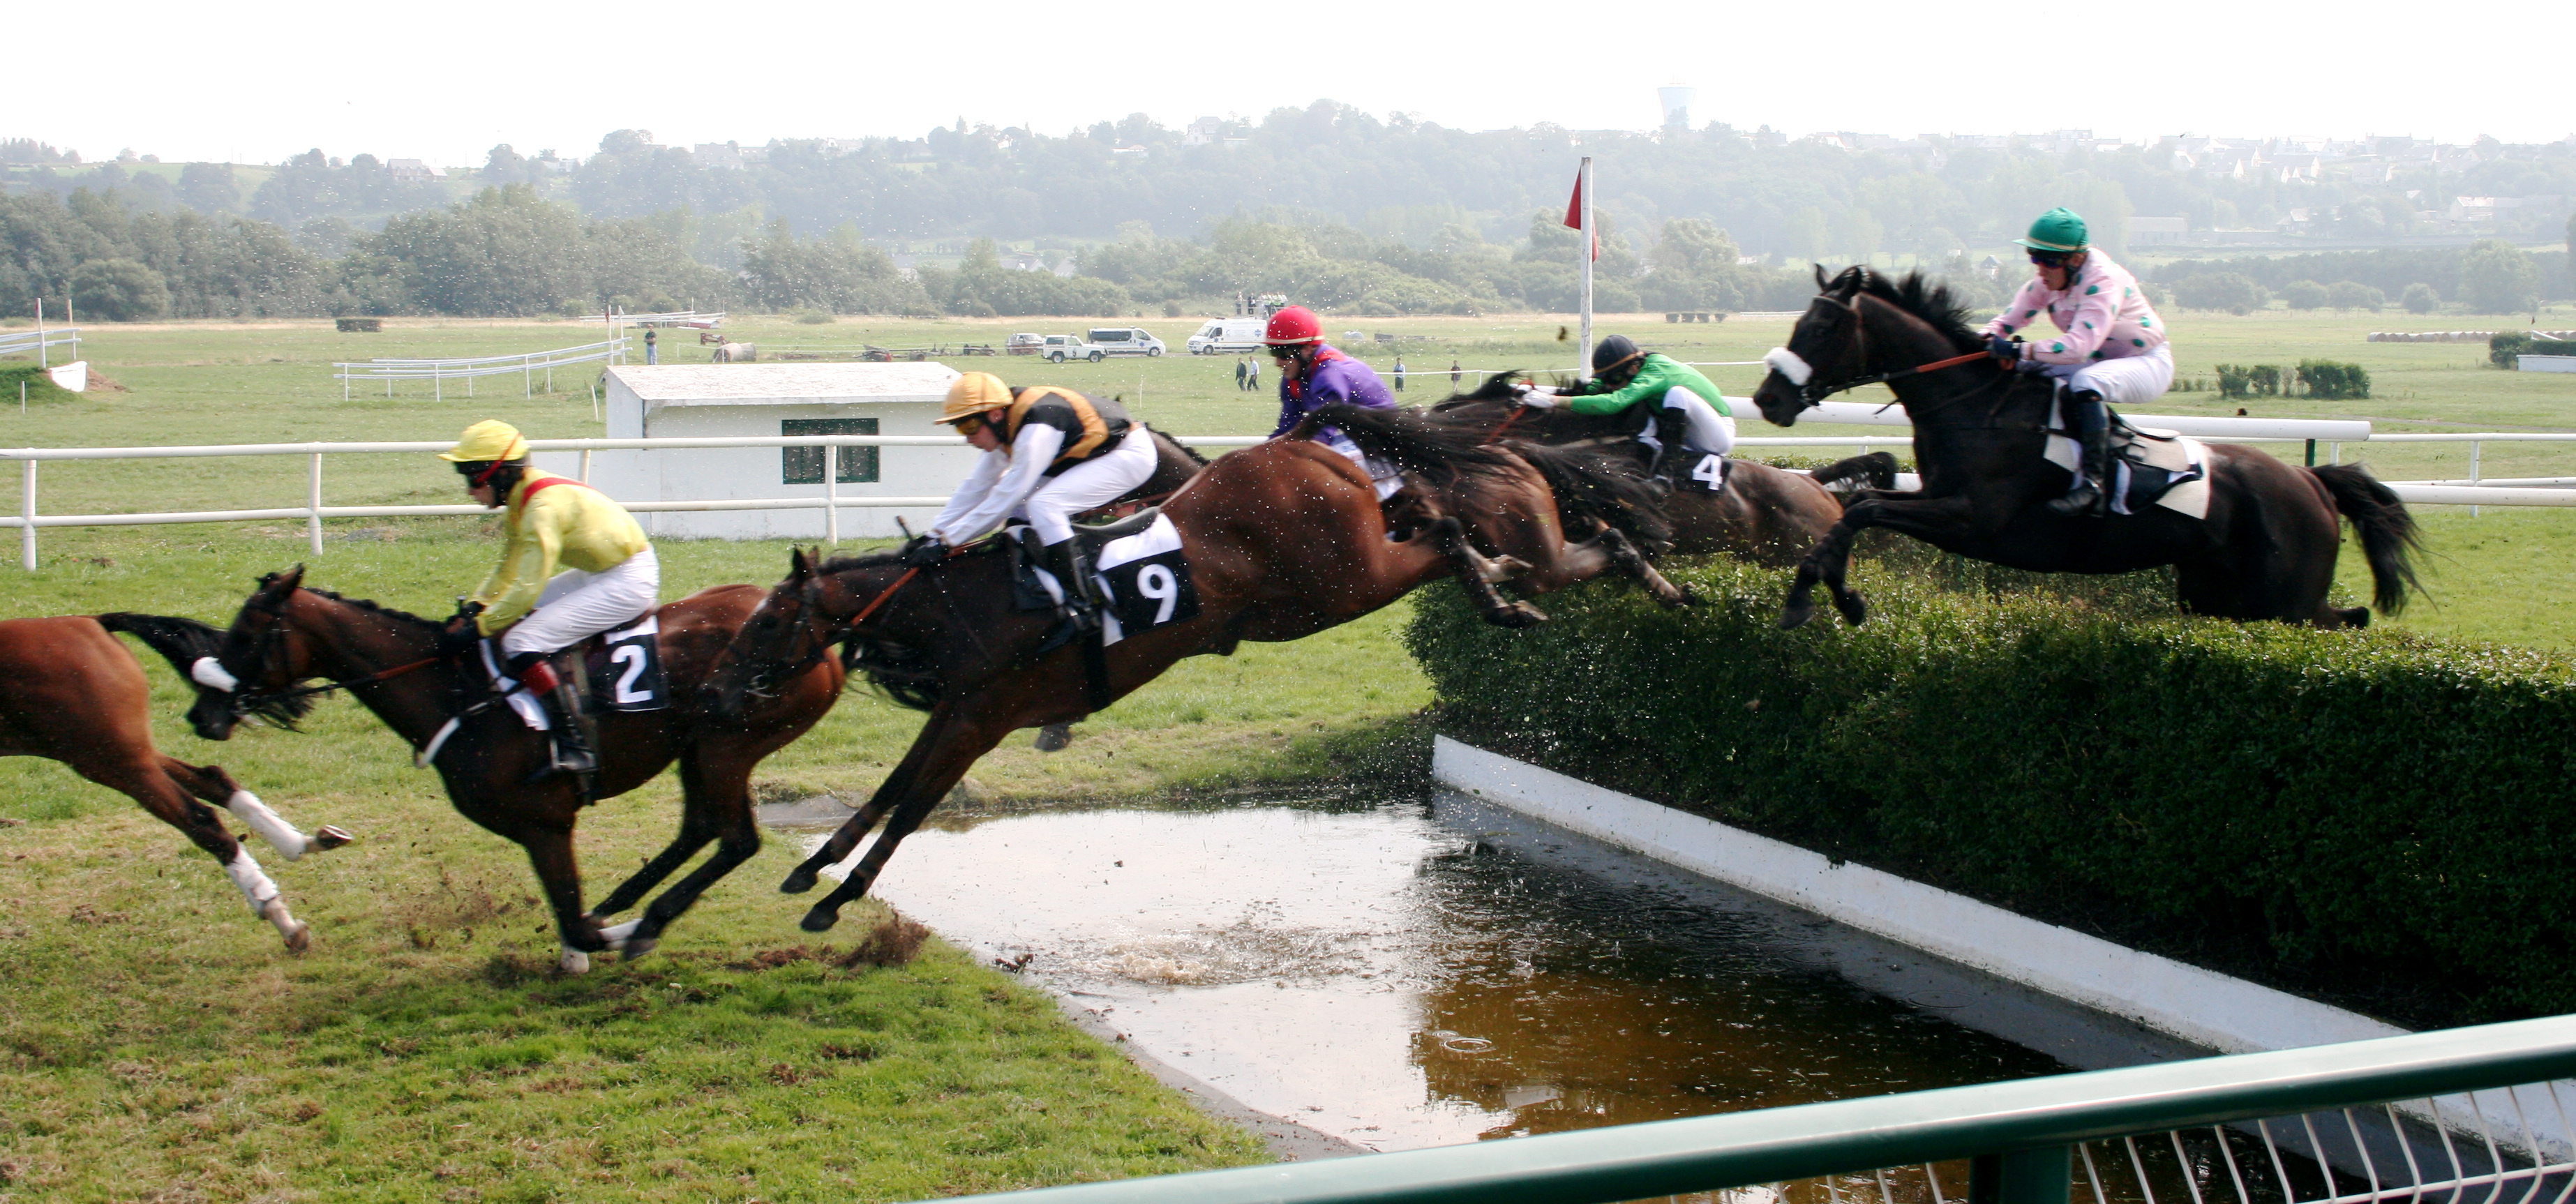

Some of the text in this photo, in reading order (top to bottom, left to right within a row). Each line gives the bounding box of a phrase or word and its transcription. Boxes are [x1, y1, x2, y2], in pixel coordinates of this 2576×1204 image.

[1692, 453, 1723, 490] 4
[1137, 564, 1178, 624] 9
[611, 645, 653, 704] 2
